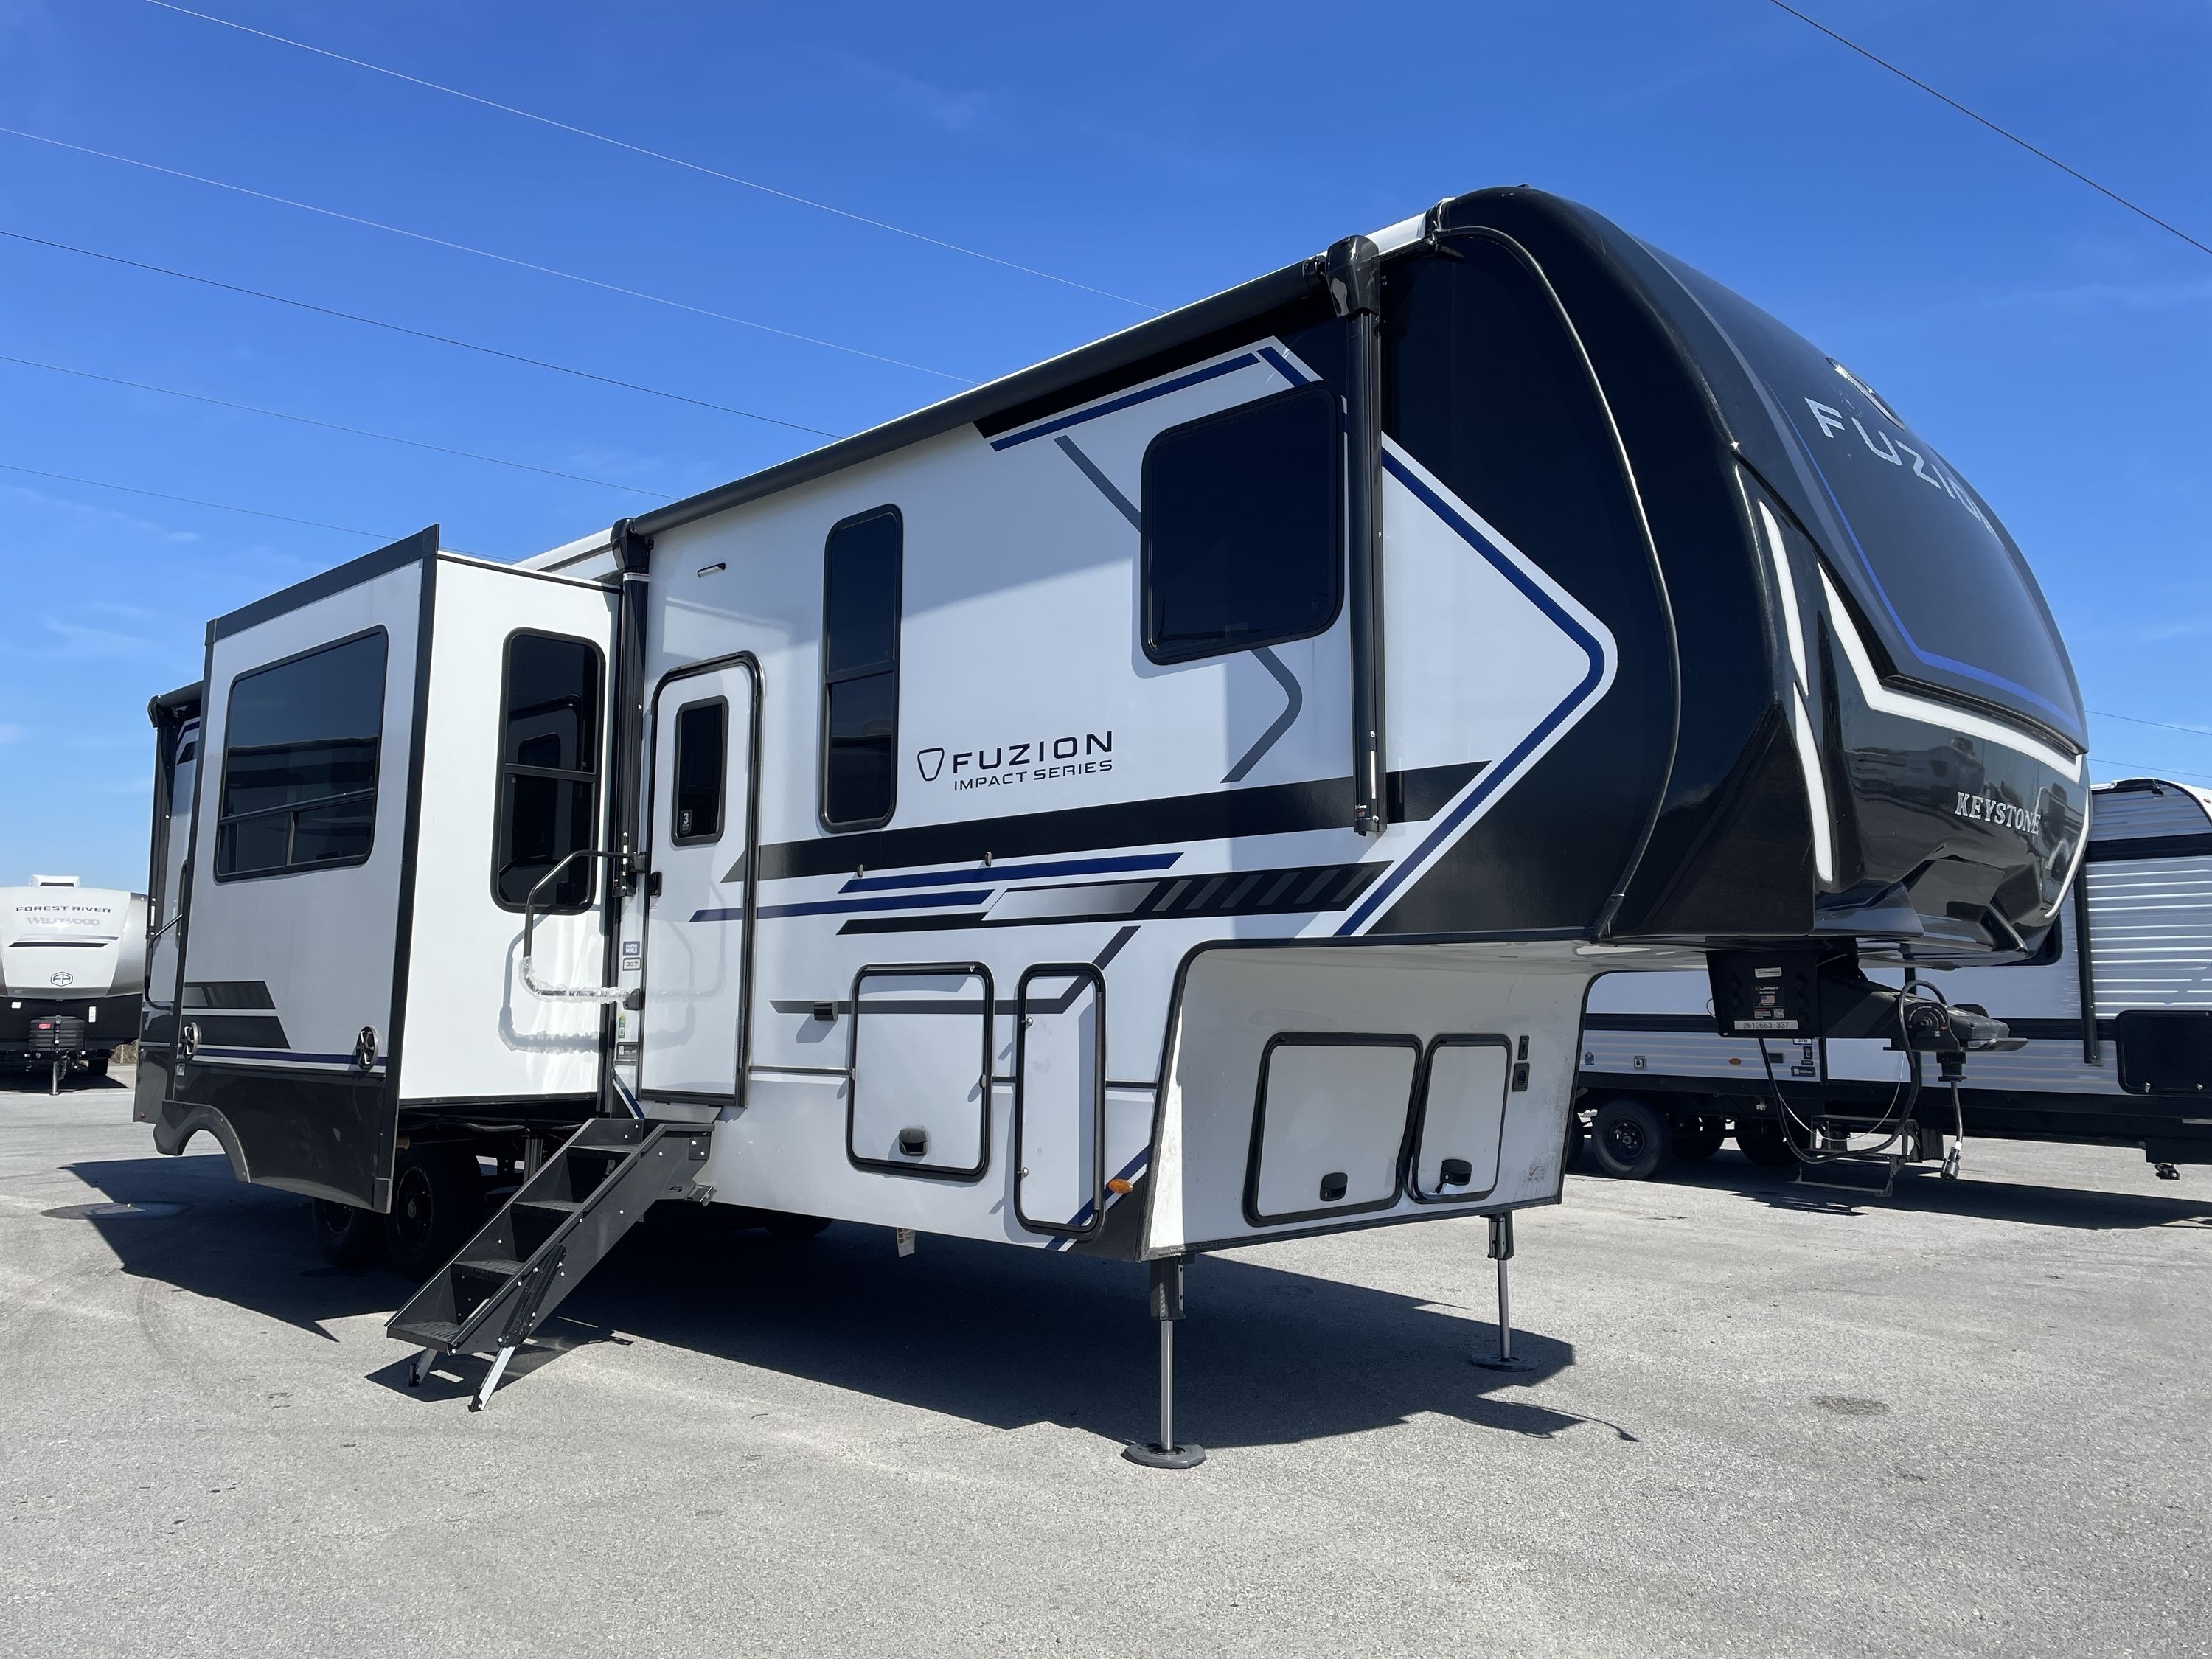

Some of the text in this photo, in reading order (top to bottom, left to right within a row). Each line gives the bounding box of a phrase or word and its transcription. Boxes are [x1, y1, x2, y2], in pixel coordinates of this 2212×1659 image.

[953, 731, 1112, 774] FUZION
[954, 759, 1113, 791] IMPACT SERIES
[683, 812, 689, 824] 3
[1955, 791, 2041, 835] KEYSTONE
